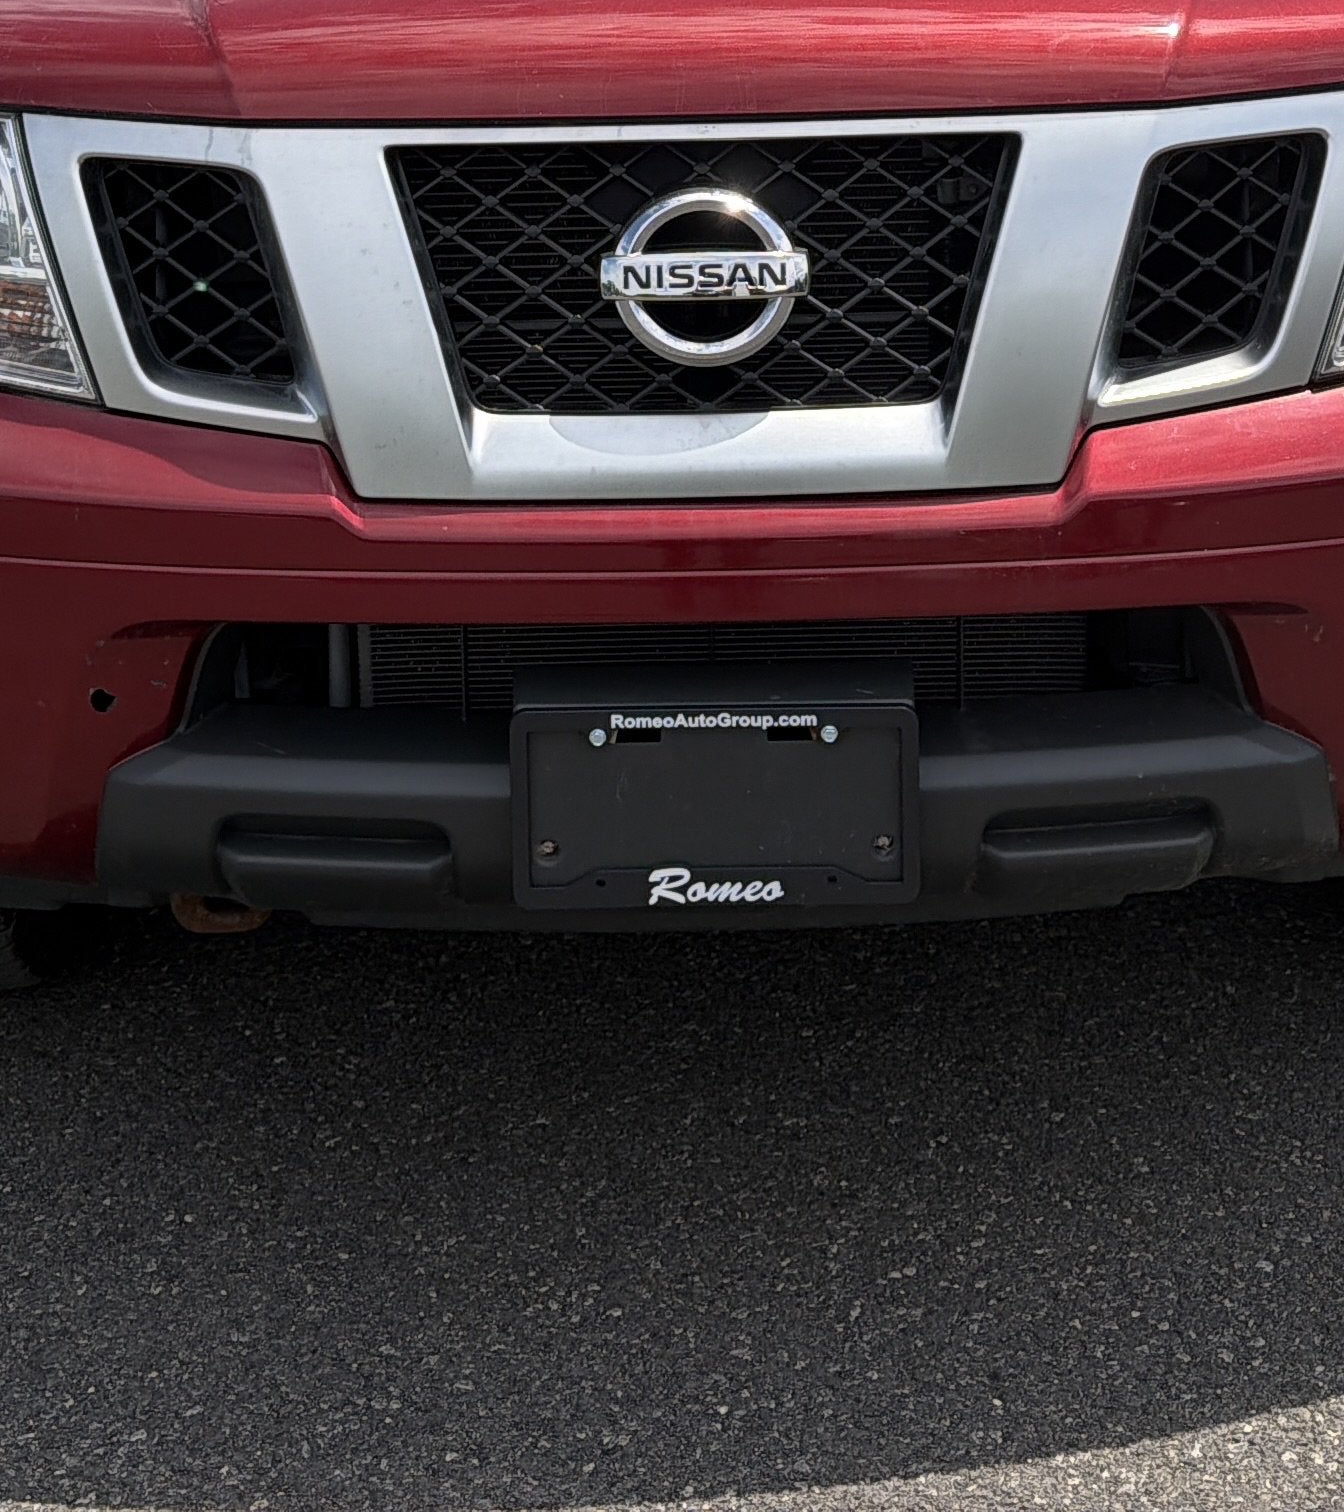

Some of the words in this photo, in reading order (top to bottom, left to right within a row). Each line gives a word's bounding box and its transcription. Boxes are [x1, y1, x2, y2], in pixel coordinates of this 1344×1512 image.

[623, 262, 787, 289] NISSAN
[610, 713, 818, 730] RomeoAutoGroup.com
[648, 867, 785, 906] Romeo
